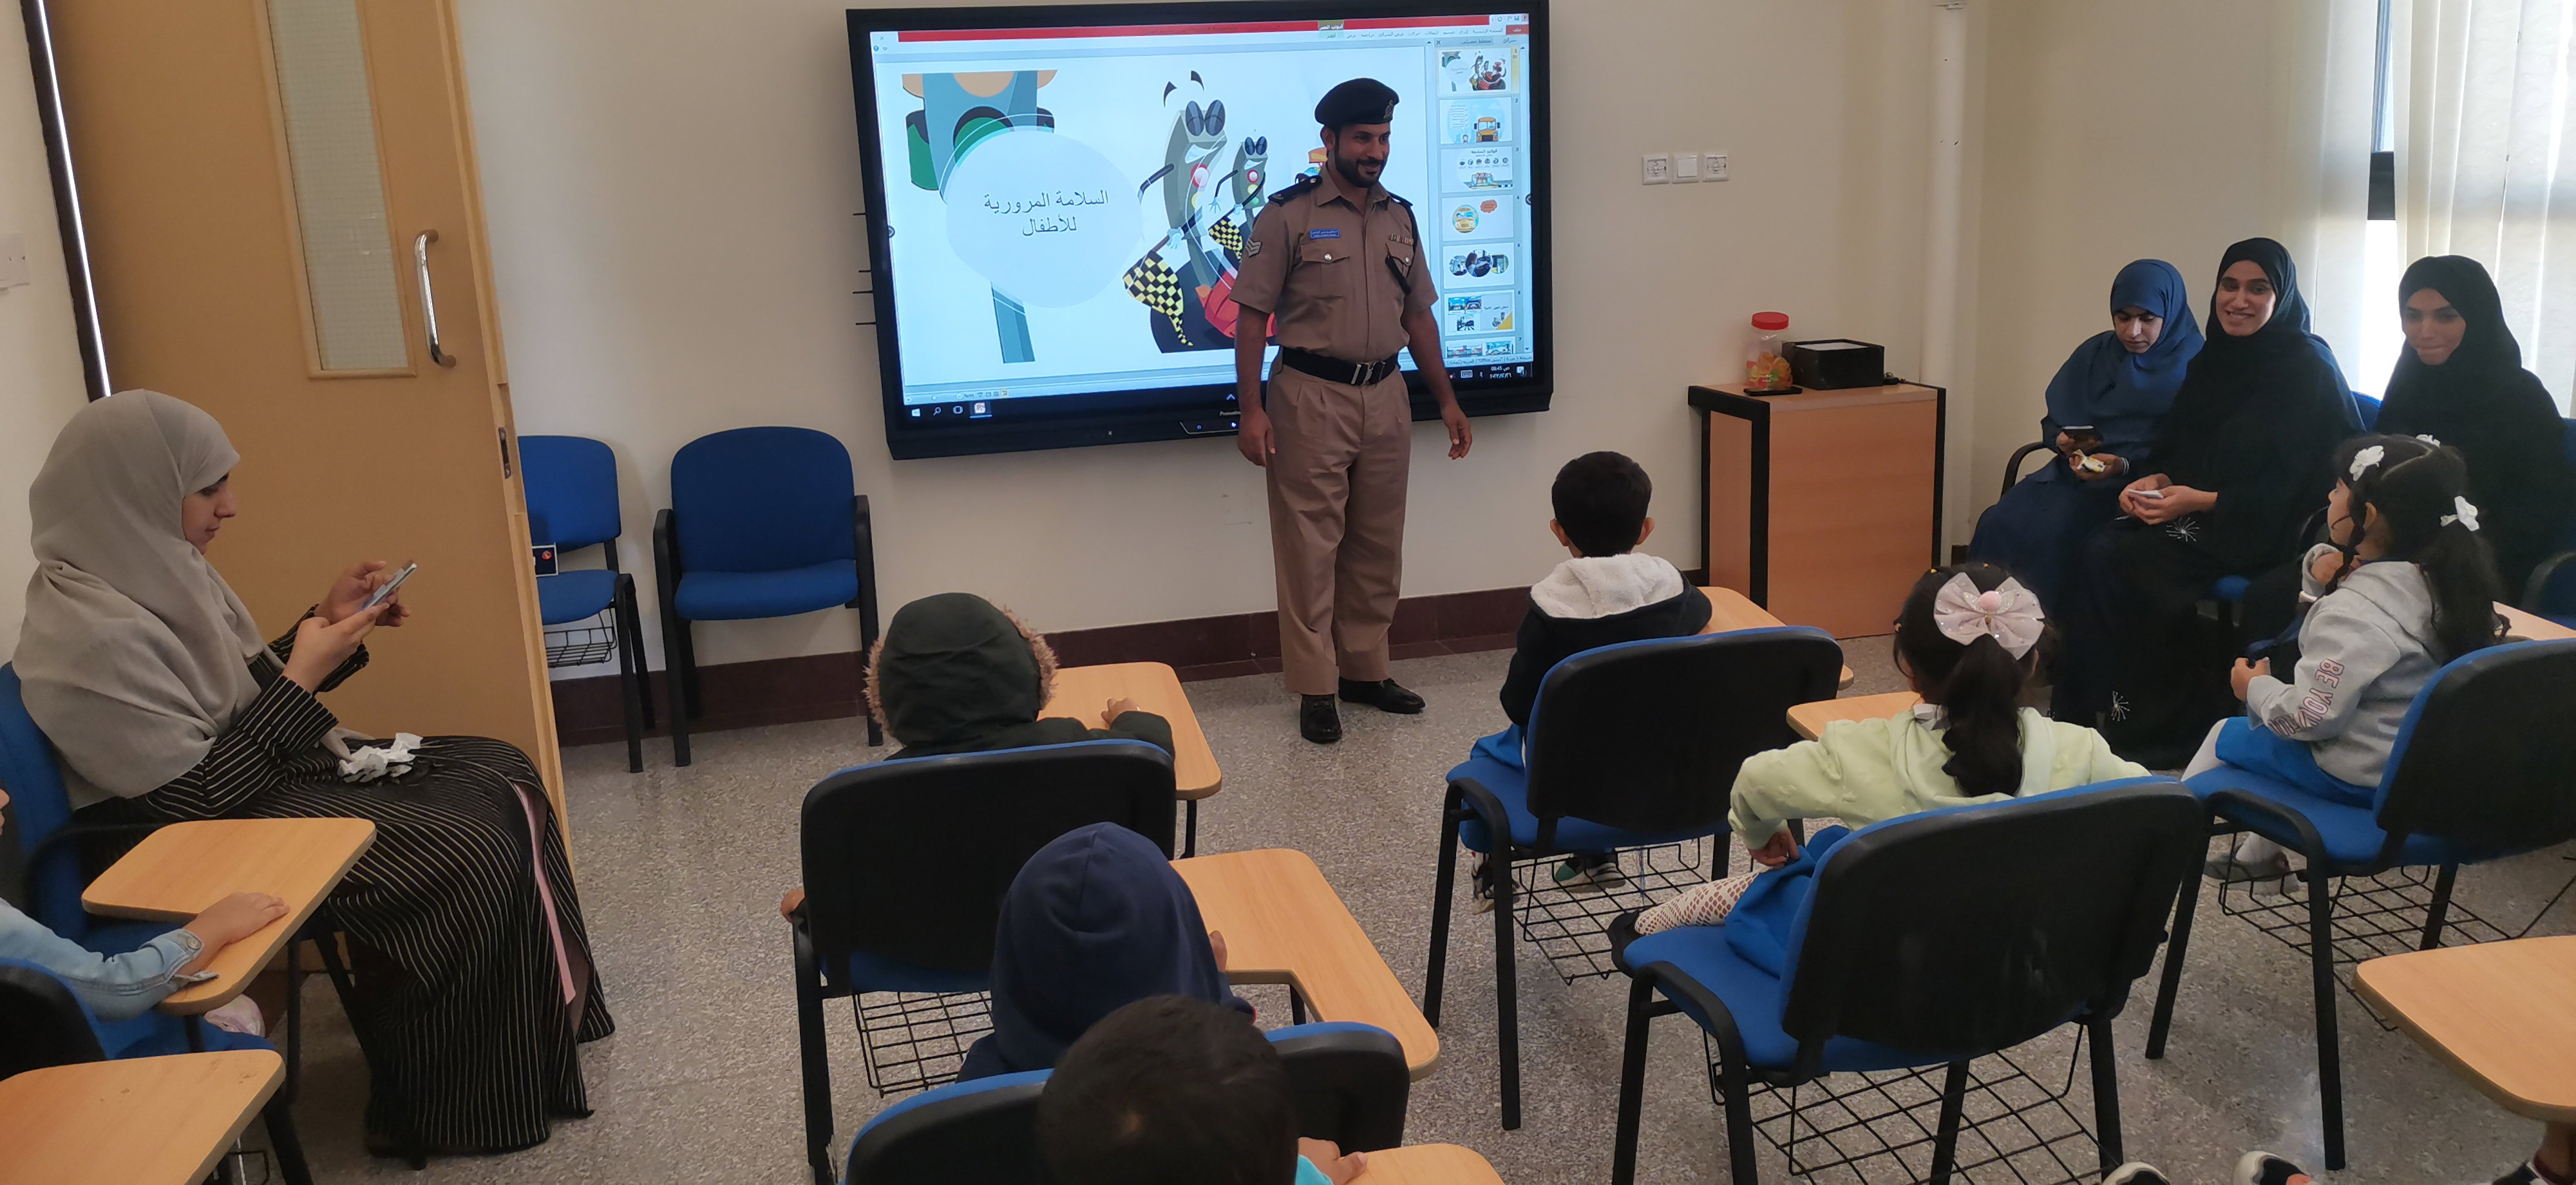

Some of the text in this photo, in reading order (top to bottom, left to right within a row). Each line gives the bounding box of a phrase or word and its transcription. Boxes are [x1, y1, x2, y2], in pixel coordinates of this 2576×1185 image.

[984, 189, 1109, 214] السلامة المرورية
[1021, 213, 1077, 236] للأطفال
[2315, 658, 2345, 688] BE
